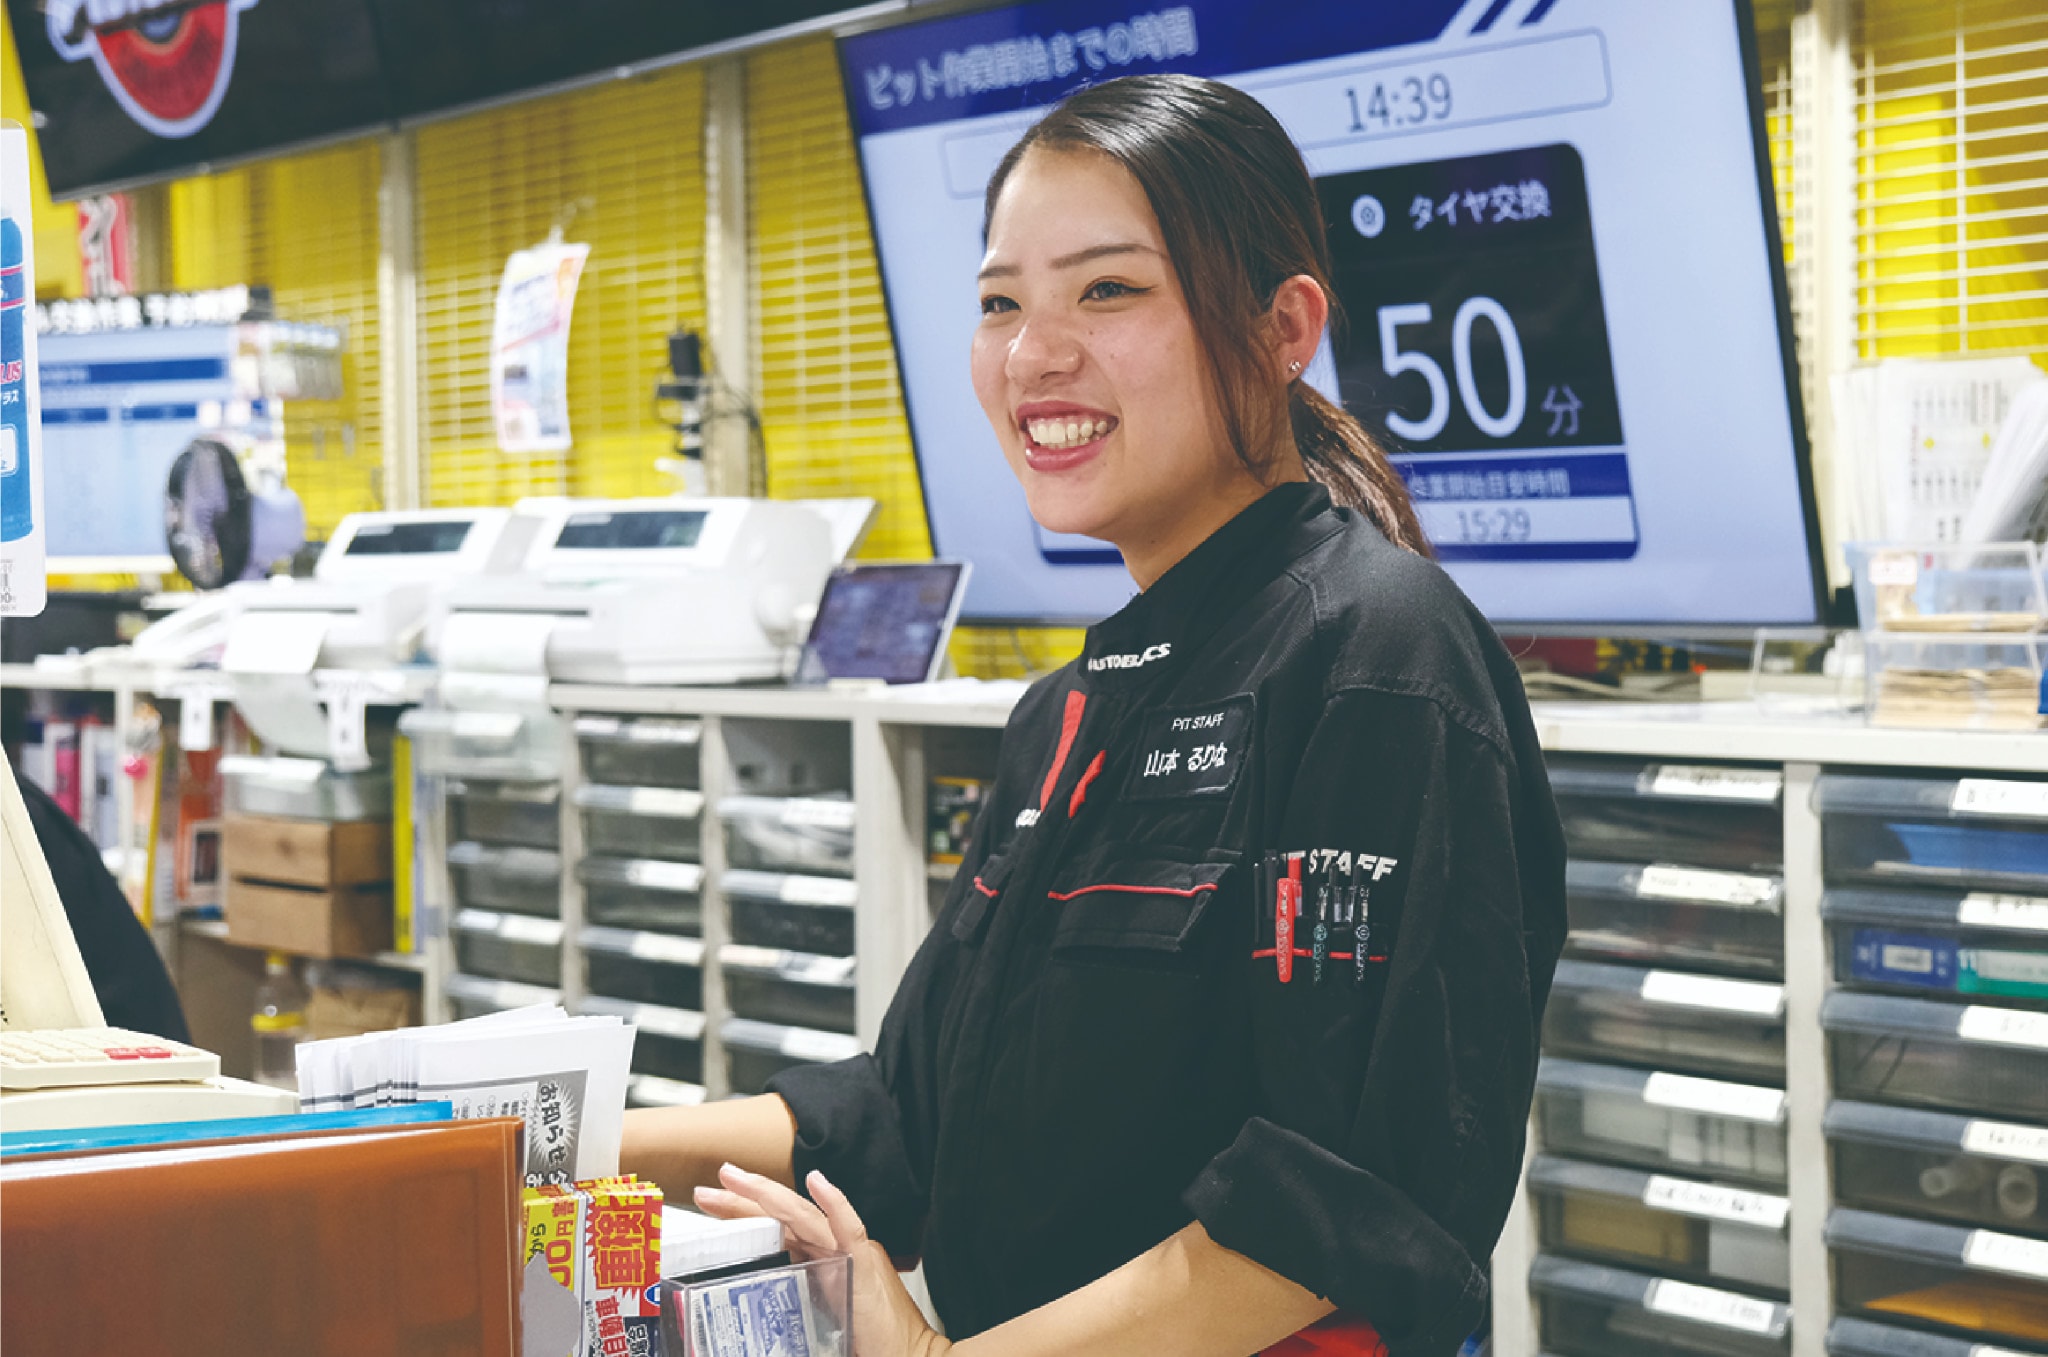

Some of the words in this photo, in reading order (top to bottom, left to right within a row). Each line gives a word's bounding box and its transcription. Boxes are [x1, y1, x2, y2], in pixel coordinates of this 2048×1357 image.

[1345, 73, 1453, 132] 14:39
[1409, 178, 1552, 231] タイヤ交換
[1457, 506, 1532, 543] 15:29
[1191, 712, 1225, 730] STAFF
[1143, 749, 1181, 777] 山本
[1308, 848, 1398, 881] STAFF
[540, 1081, 567, 1163] お知らせ
[527, 1222, 547, 1263] から
[595, 1210, 646, 1287] 車検
[595, 1296, 629, 1357] 自動車
